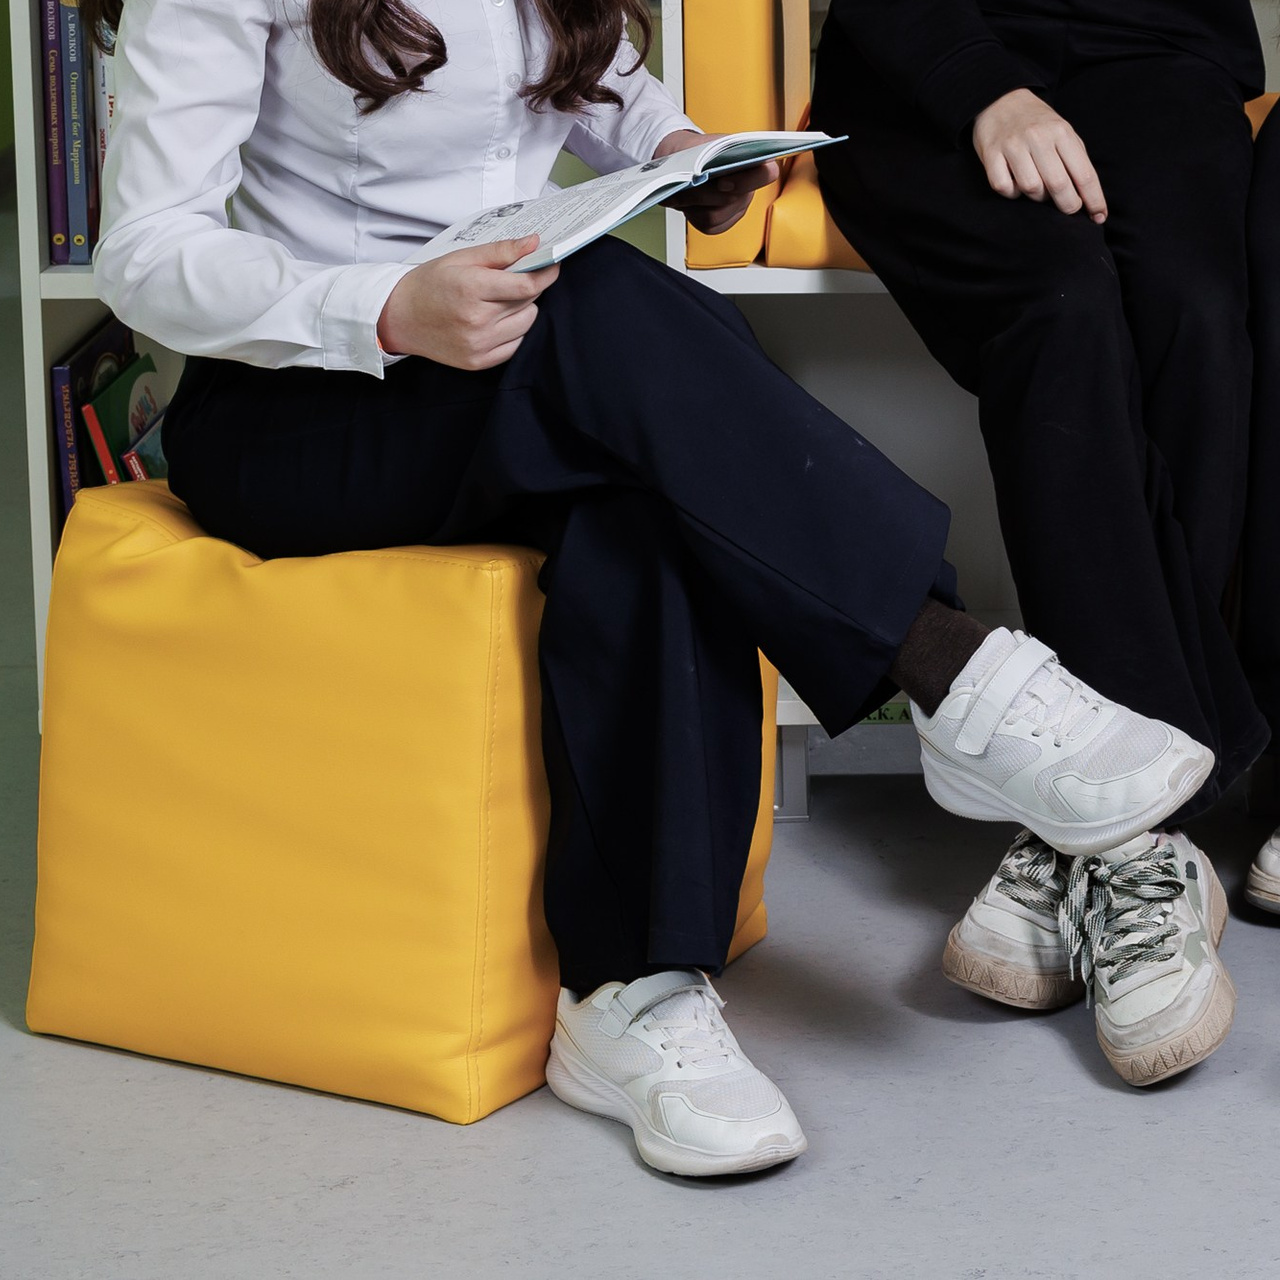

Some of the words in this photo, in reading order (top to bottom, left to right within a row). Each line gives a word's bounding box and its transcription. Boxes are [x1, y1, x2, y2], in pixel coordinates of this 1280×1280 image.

[47, 1, 56, 40] ВОЛКОВ
[48, 49, 58, 73] Семь
[68, 23, 77, 62] ВОЛКОВ
[69, 71, 79, 120] Огненный
[48, 127, 60, 165] королей
[72, 121, 81, 137] бог
[69, 140, 82, 185] Марранов
